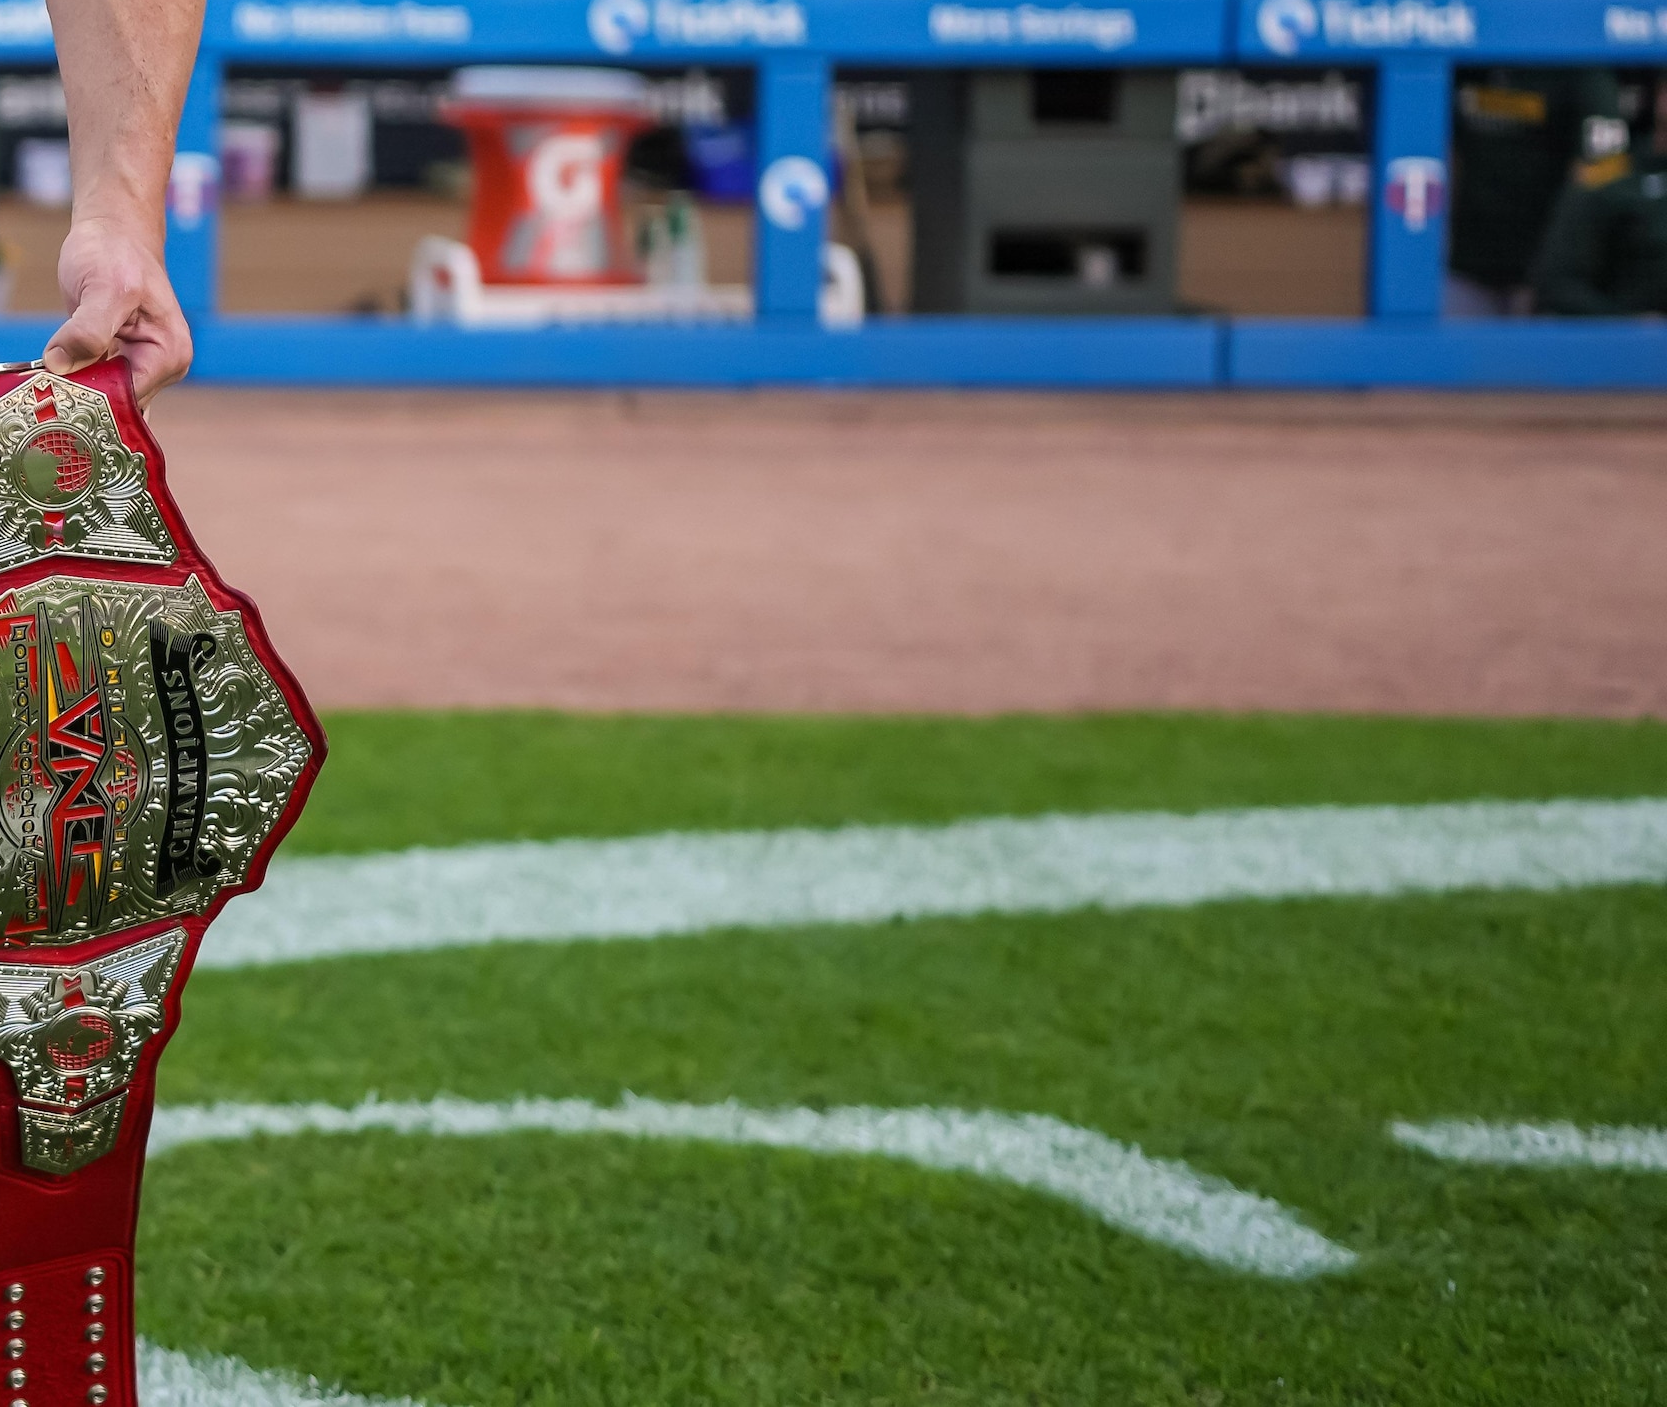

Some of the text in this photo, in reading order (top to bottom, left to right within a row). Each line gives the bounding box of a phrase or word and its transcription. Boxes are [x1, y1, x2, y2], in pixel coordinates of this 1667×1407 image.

[1323, 0, 1474, 47] TickPick
[530, 134, 603, 219] G
[9, 621, 38, 923] TOTAL NONSTOP ACTION
[48, 689, 106, 888] TNA
[99, 624, 131, 905] WRESTLING
[161, 668, 199, 860] CHAMPIONS
